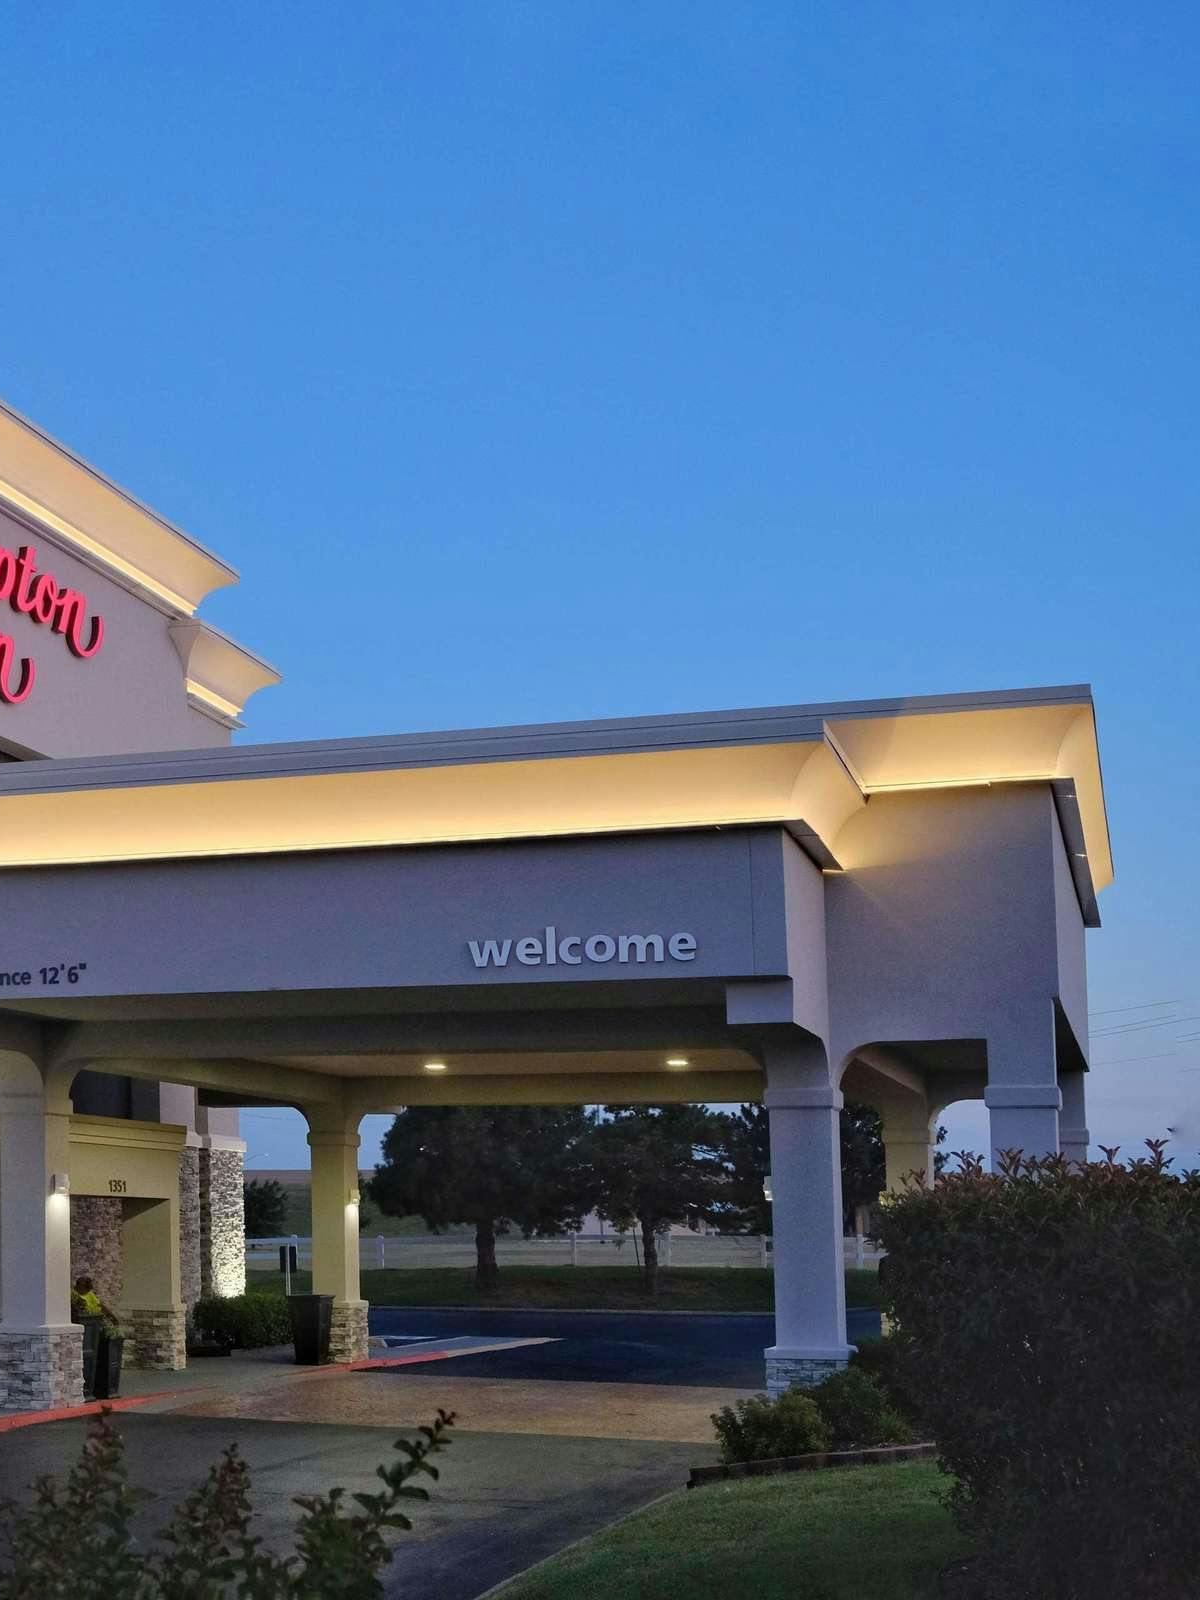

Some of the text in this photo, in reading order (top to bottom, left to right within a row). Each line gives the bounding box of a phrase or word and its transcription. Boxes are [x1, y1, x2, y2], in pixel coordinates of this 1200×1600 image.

[467, 926, 697, 968] welcome
[39, 963, 87, 985] 12'6"
[108, 1179, 127, 1193] 1351
